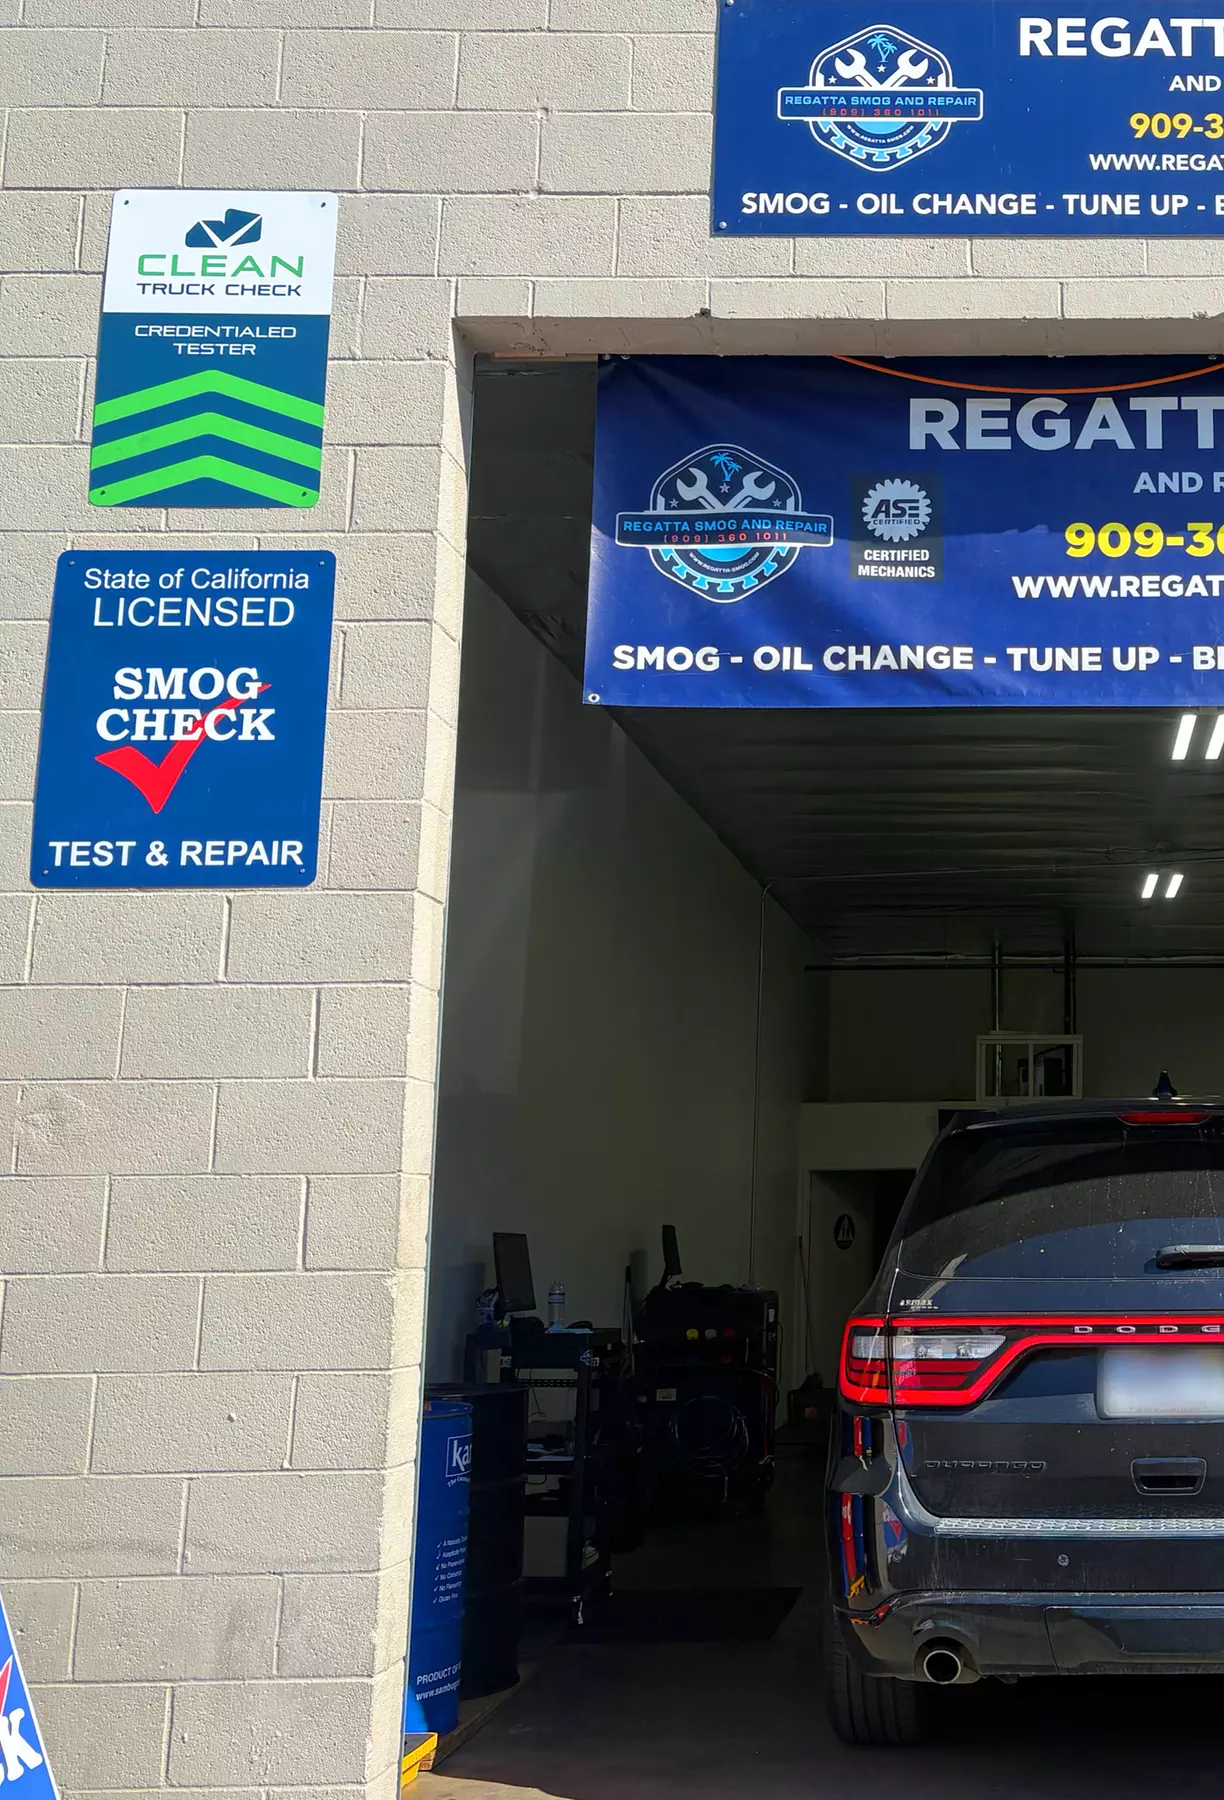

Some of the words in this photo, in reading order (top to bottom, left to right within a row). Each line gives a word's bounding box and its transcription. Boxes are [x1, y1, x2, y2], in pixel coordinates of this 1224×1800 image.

[1169, 76, 1221, 91] AND
[785, 96, 847, 106] REGATTA
[851, 96, 891, 106] SMOG
[895, 96, 924, 106] AND
[928, 97, 977, 106] REPAIR
[822, 108, 865, 116] (909)
[742, 193, 829, 214] SMOG
[857, 193, 904, 214] OIL
[913, 194, 1036, 214] CHANGE
[1063, 195, 1140, 215] TUNE
[1151, 195, 1188, 215] UP
[137, 254, 304, 278] CLEAN
[136, 283, 216, 296] TRUCK
[225, 284, 302, 297] CHECK
[135, 326, 296, 338] CREDENTIALED
[173, 343, 256, 355] TESTER
[1134, 472, 1203, 493] AND
[870, 499, 920, 518] ASE
[623, 520, 690, 531] REGATTA
[694, 519, 737, 531] SMOG
[741, 519, 771, 530] AND
[775, 520, 827, 533] REPAIR
[664, 534, 709, 543] (909)
[718, 533, 747, 542] 360
[756, 532, 787, 541] 1011
[864, 550, 929, 561] CERTIFIED
[85, 568, 150, 589] State
[159, 568, 184, 588] of
[192, 568, 308, 589] California
[858, 565, 935, 577] MECHANICS
[94, 597, 294, 626] LICENSED
[612, 645, 719, 671] SMOG
[752, 646, 812, 672] OIL
[823, 645, 974, 670] CHANGE
[1006, 647, 1102, 671] TUNE
[1112, 647, 1160, 671] UP
[114, 667, 261, 700] SMOG
[96, 708, 275, 741] CHECK
[49, 841, 136, 866] TEST
[146, 841, 168, 866] &
[181, 841, 303, 865] REPAIR
[417, 1667, 452, 1686] PRODUCT
